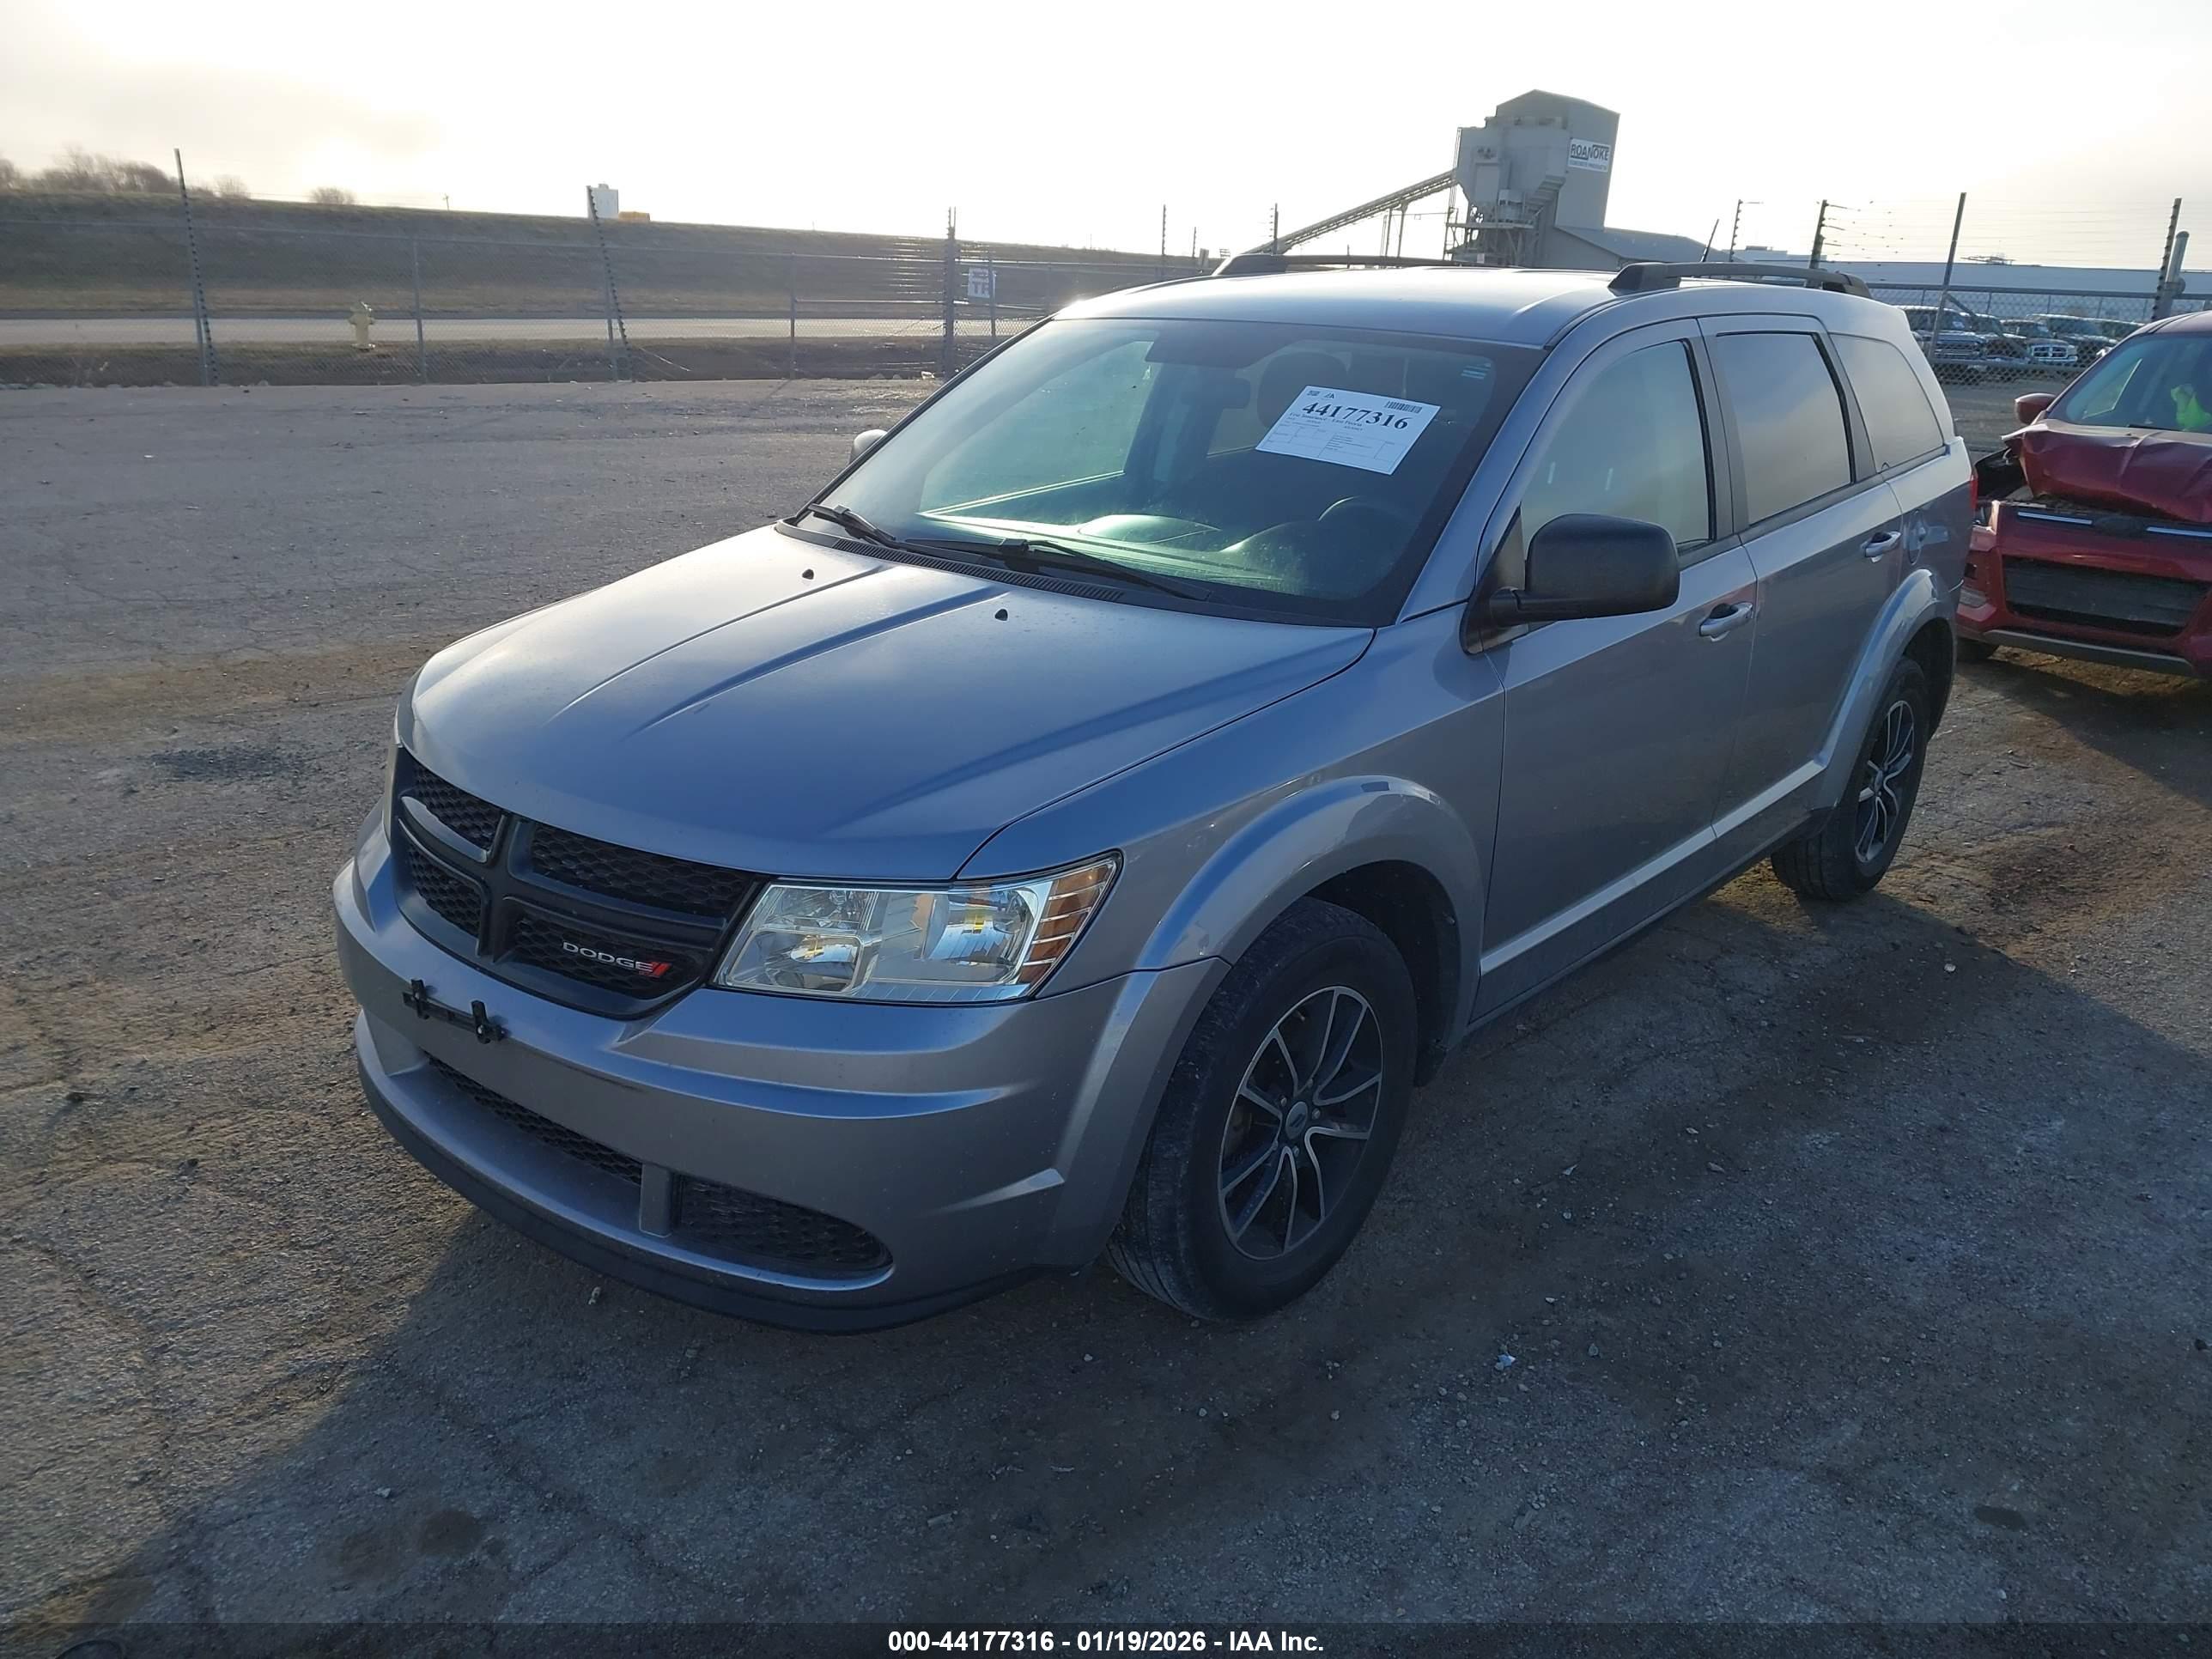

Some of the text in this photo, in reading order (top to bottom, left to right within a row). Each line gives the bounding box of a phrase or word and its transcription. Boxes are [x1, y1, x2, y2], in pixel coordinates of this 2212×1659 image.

[1571, 143, 1609, 161] ROANOKE
[1302, 402, 1413, 429] 44177316
[562, 941, 654, 973] DODGE
